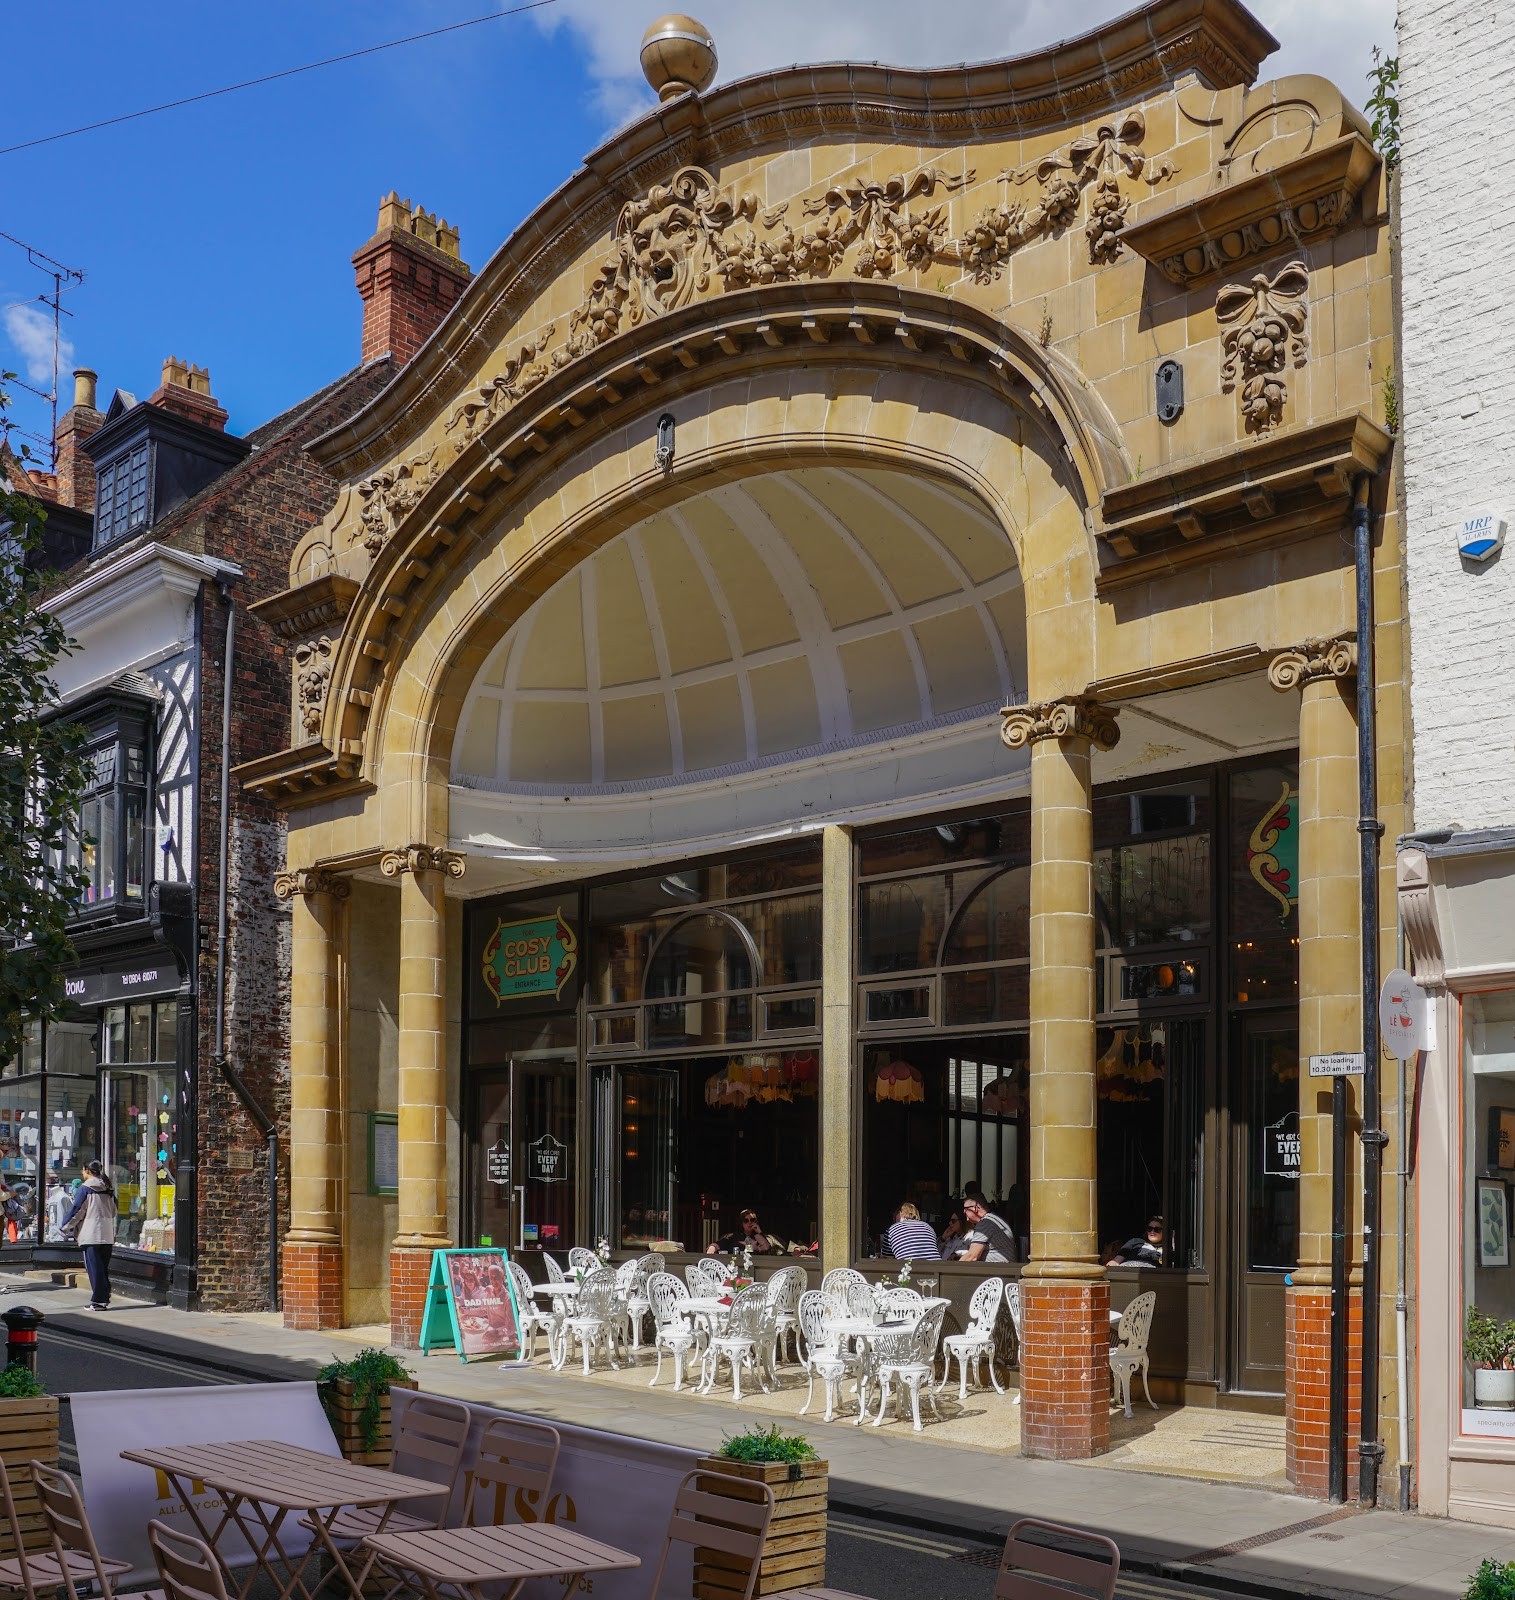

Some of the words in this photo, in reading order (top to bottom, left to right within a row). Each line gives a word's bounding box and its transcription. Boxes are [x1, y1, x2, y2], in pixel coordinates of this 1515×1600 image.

[1463, 516, 1492, 532] MRP
[504, 936, 552, 959] COSY
[504, 955, 551, 977] CLUB
[514, 979, 541, 989] ENTRANCE
[1275, 1133, 1285, 1141] WE
[1285, 1133, 1296, 1141] ARE
[537, 1155, 559, 1165] EVERY
[541, 1164, 555, 1174] DAY
[159, 1506, 177, 1516] ALL
[179, 1502, 201, 1513] DY
